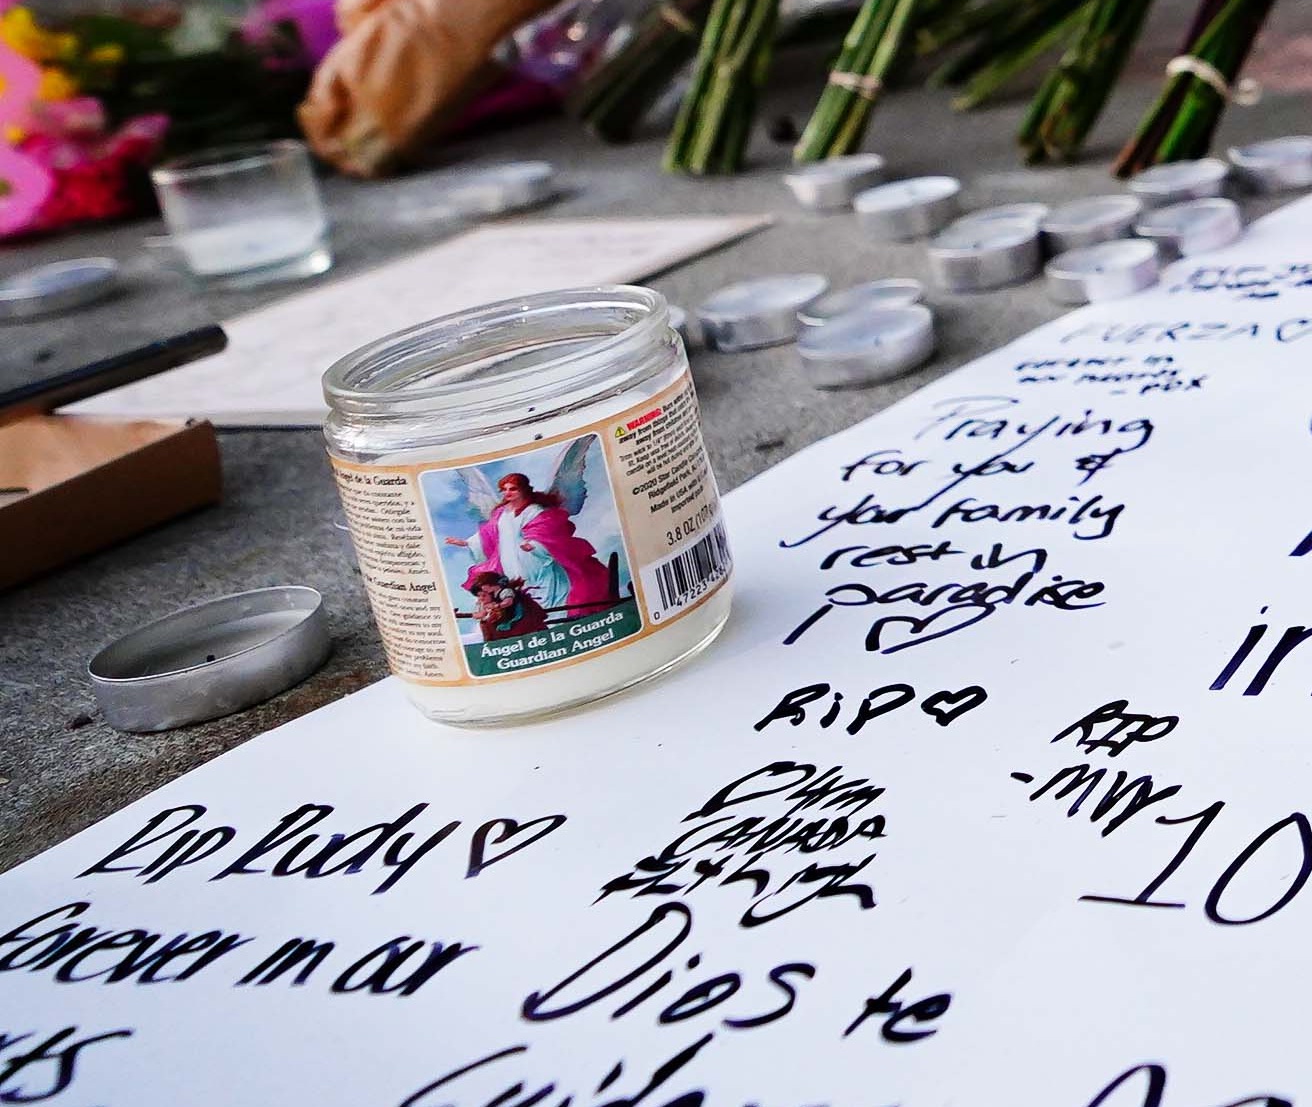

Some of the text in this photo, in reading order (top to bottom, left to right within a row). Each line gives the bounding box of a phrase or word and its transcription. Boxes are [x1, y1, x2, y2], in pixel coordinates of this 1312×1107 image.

[914, 395, 1156, 465] Praying
[840, 449, 930, 484] for
[666, 517, 696, 546] 3.8 OZ
[779, 493, 1126, 550] your family
[818, 541, 1049, 575] rest in
[409, 580, 437, 594] Angel
[782, 572, 1107, 646] paradise
[481, 611, 624, 658] Ángel de la Guarda
[653, 611, 661, 621] 0
[496, 628, 615, 669] Guardian Angel
[207, 800, 463, 896] Rudy
[235, 935, 322, 988] in
[331, 934, 483, 999] our
[521, 900, 952, 1043] Dios te
